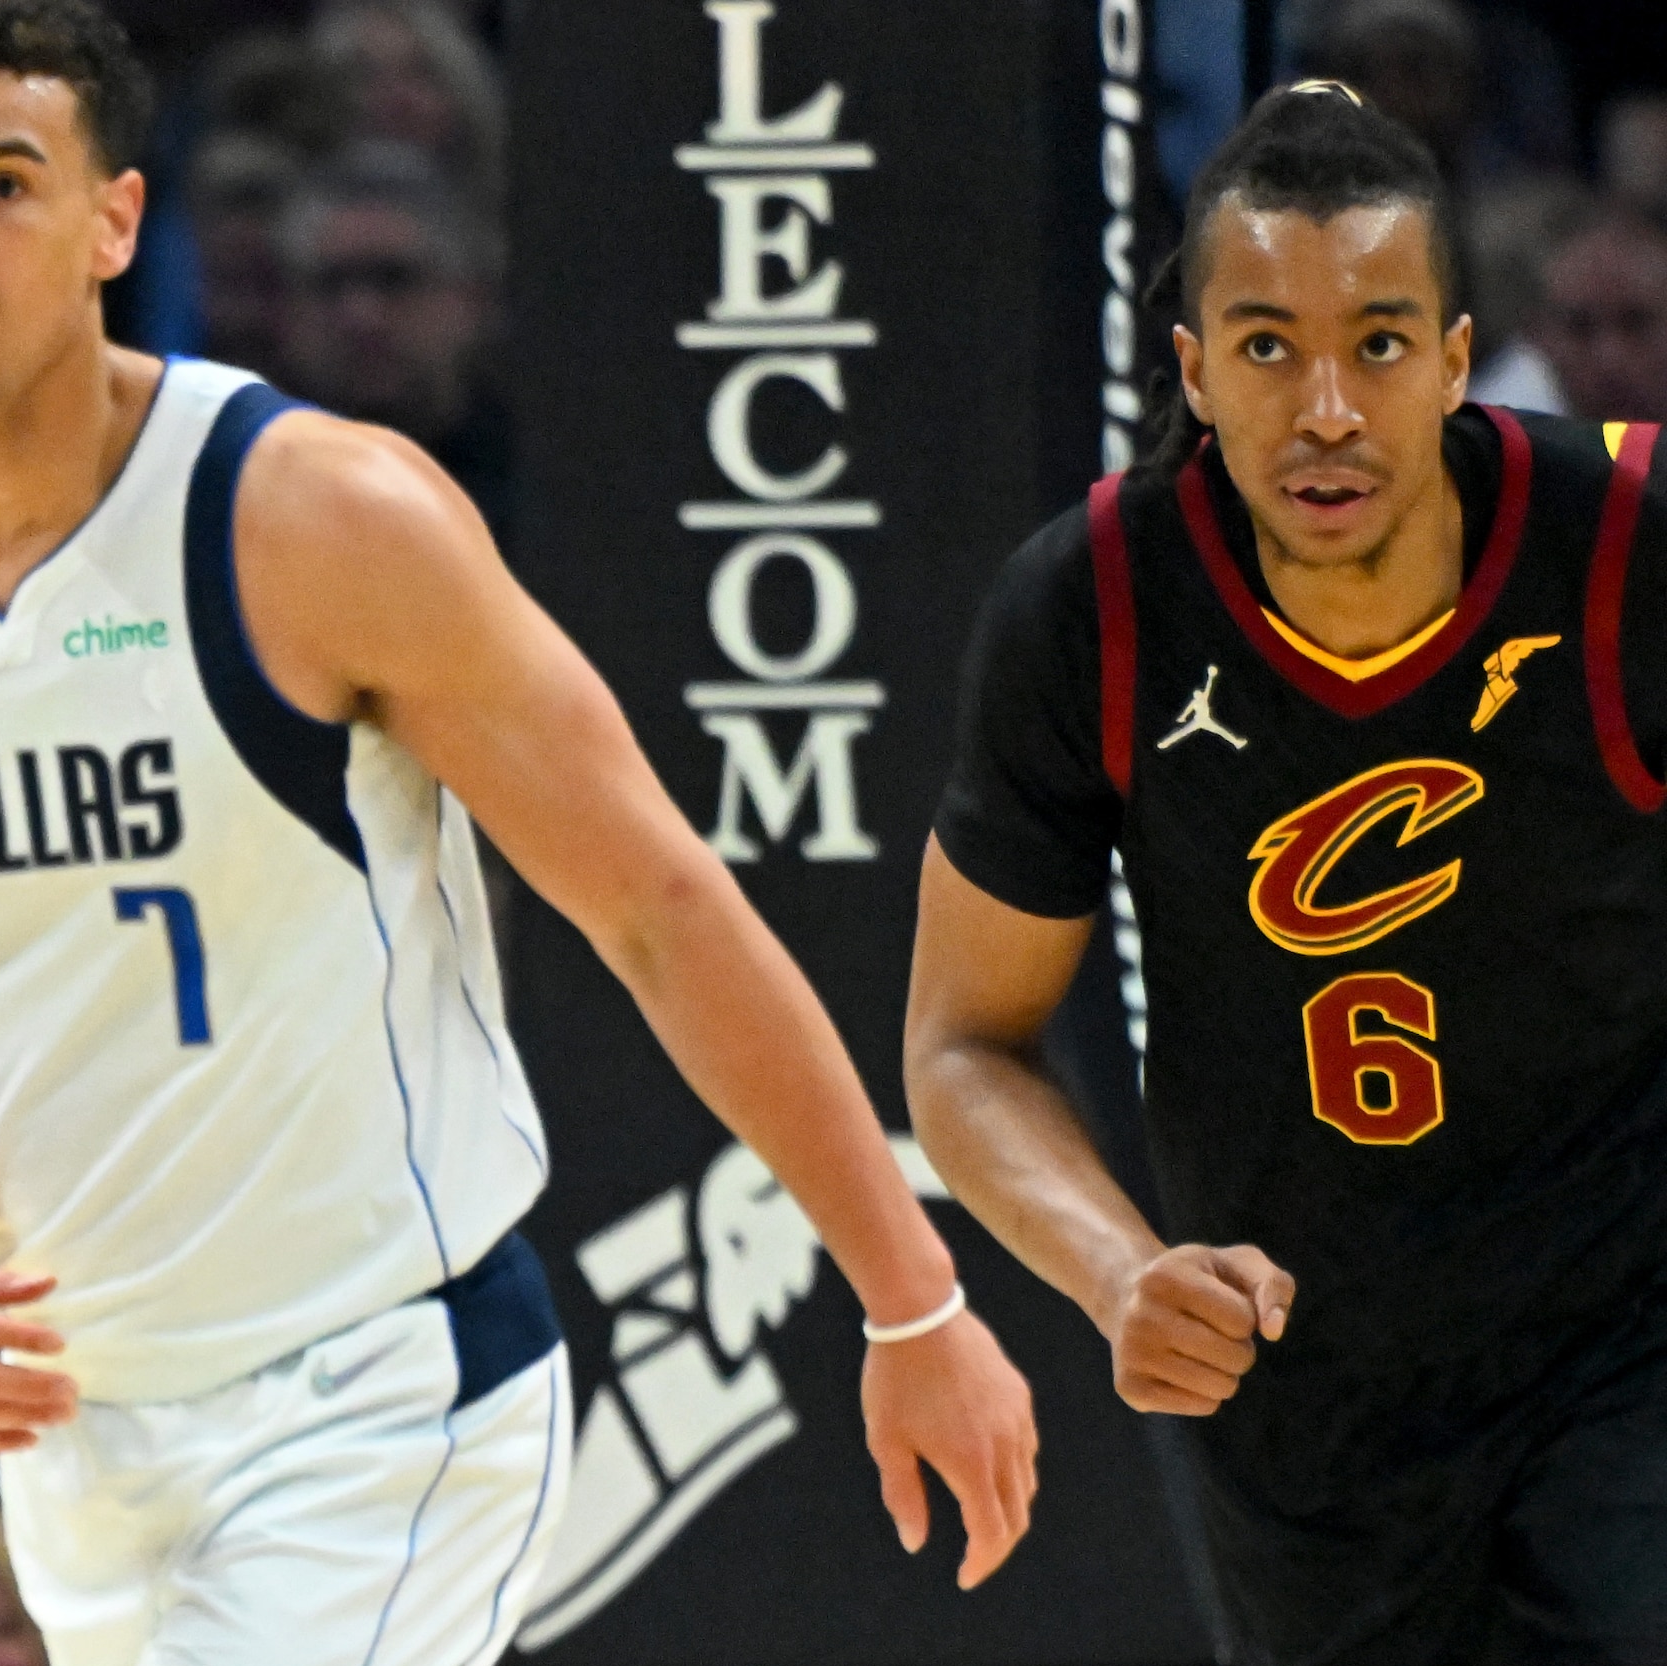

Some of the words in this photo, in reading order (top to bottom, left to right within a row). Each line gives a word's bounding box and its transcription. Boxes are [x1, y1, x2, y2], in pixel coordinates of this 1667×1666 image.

[699, 0, 879, 862] LECOM
[62, 616, 170, 658] chime
[111, 884, 214, 1047] 7
[1302, 972, 1445, 1146] 6
